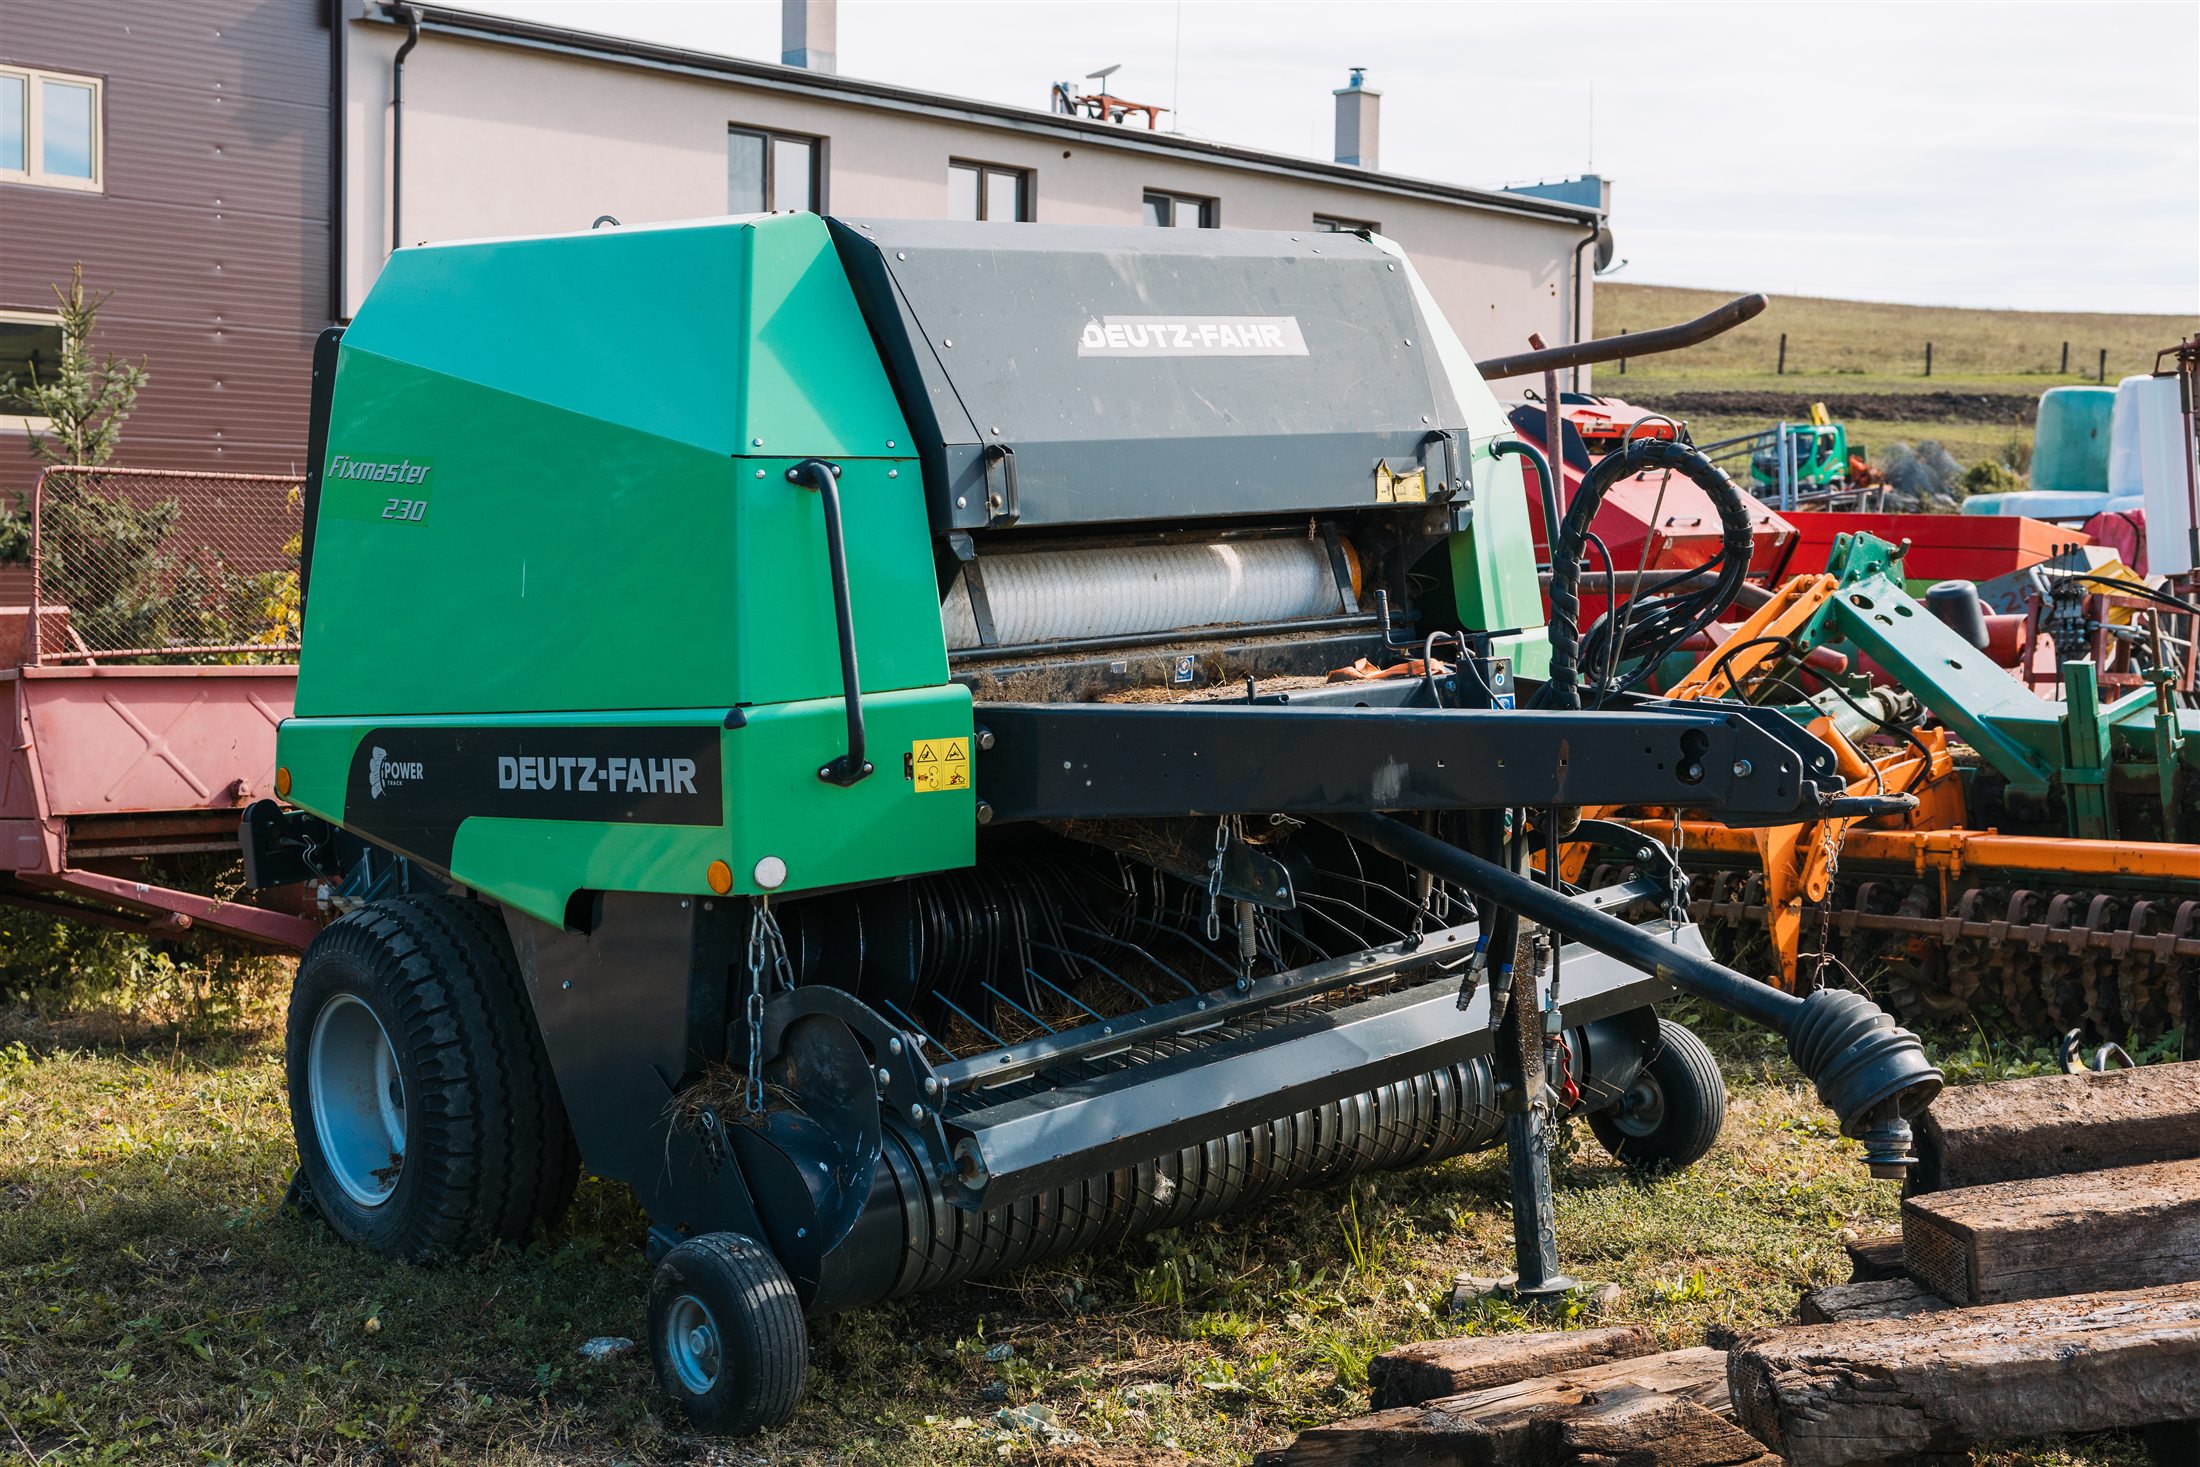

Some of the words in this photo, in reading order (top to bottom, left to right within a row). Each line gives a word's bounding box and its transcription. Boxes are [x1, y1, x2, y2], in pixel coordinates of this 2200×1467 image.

[1083, 324, 1284, 347] DEUTZ-FAHR
[328, 456, 430, 485] Fixmaster
[381, 498, 427, 521] 230
[384, 762, 424, 779] POWER
[498, 756, 697, 794] DEUTZ-FAHR
